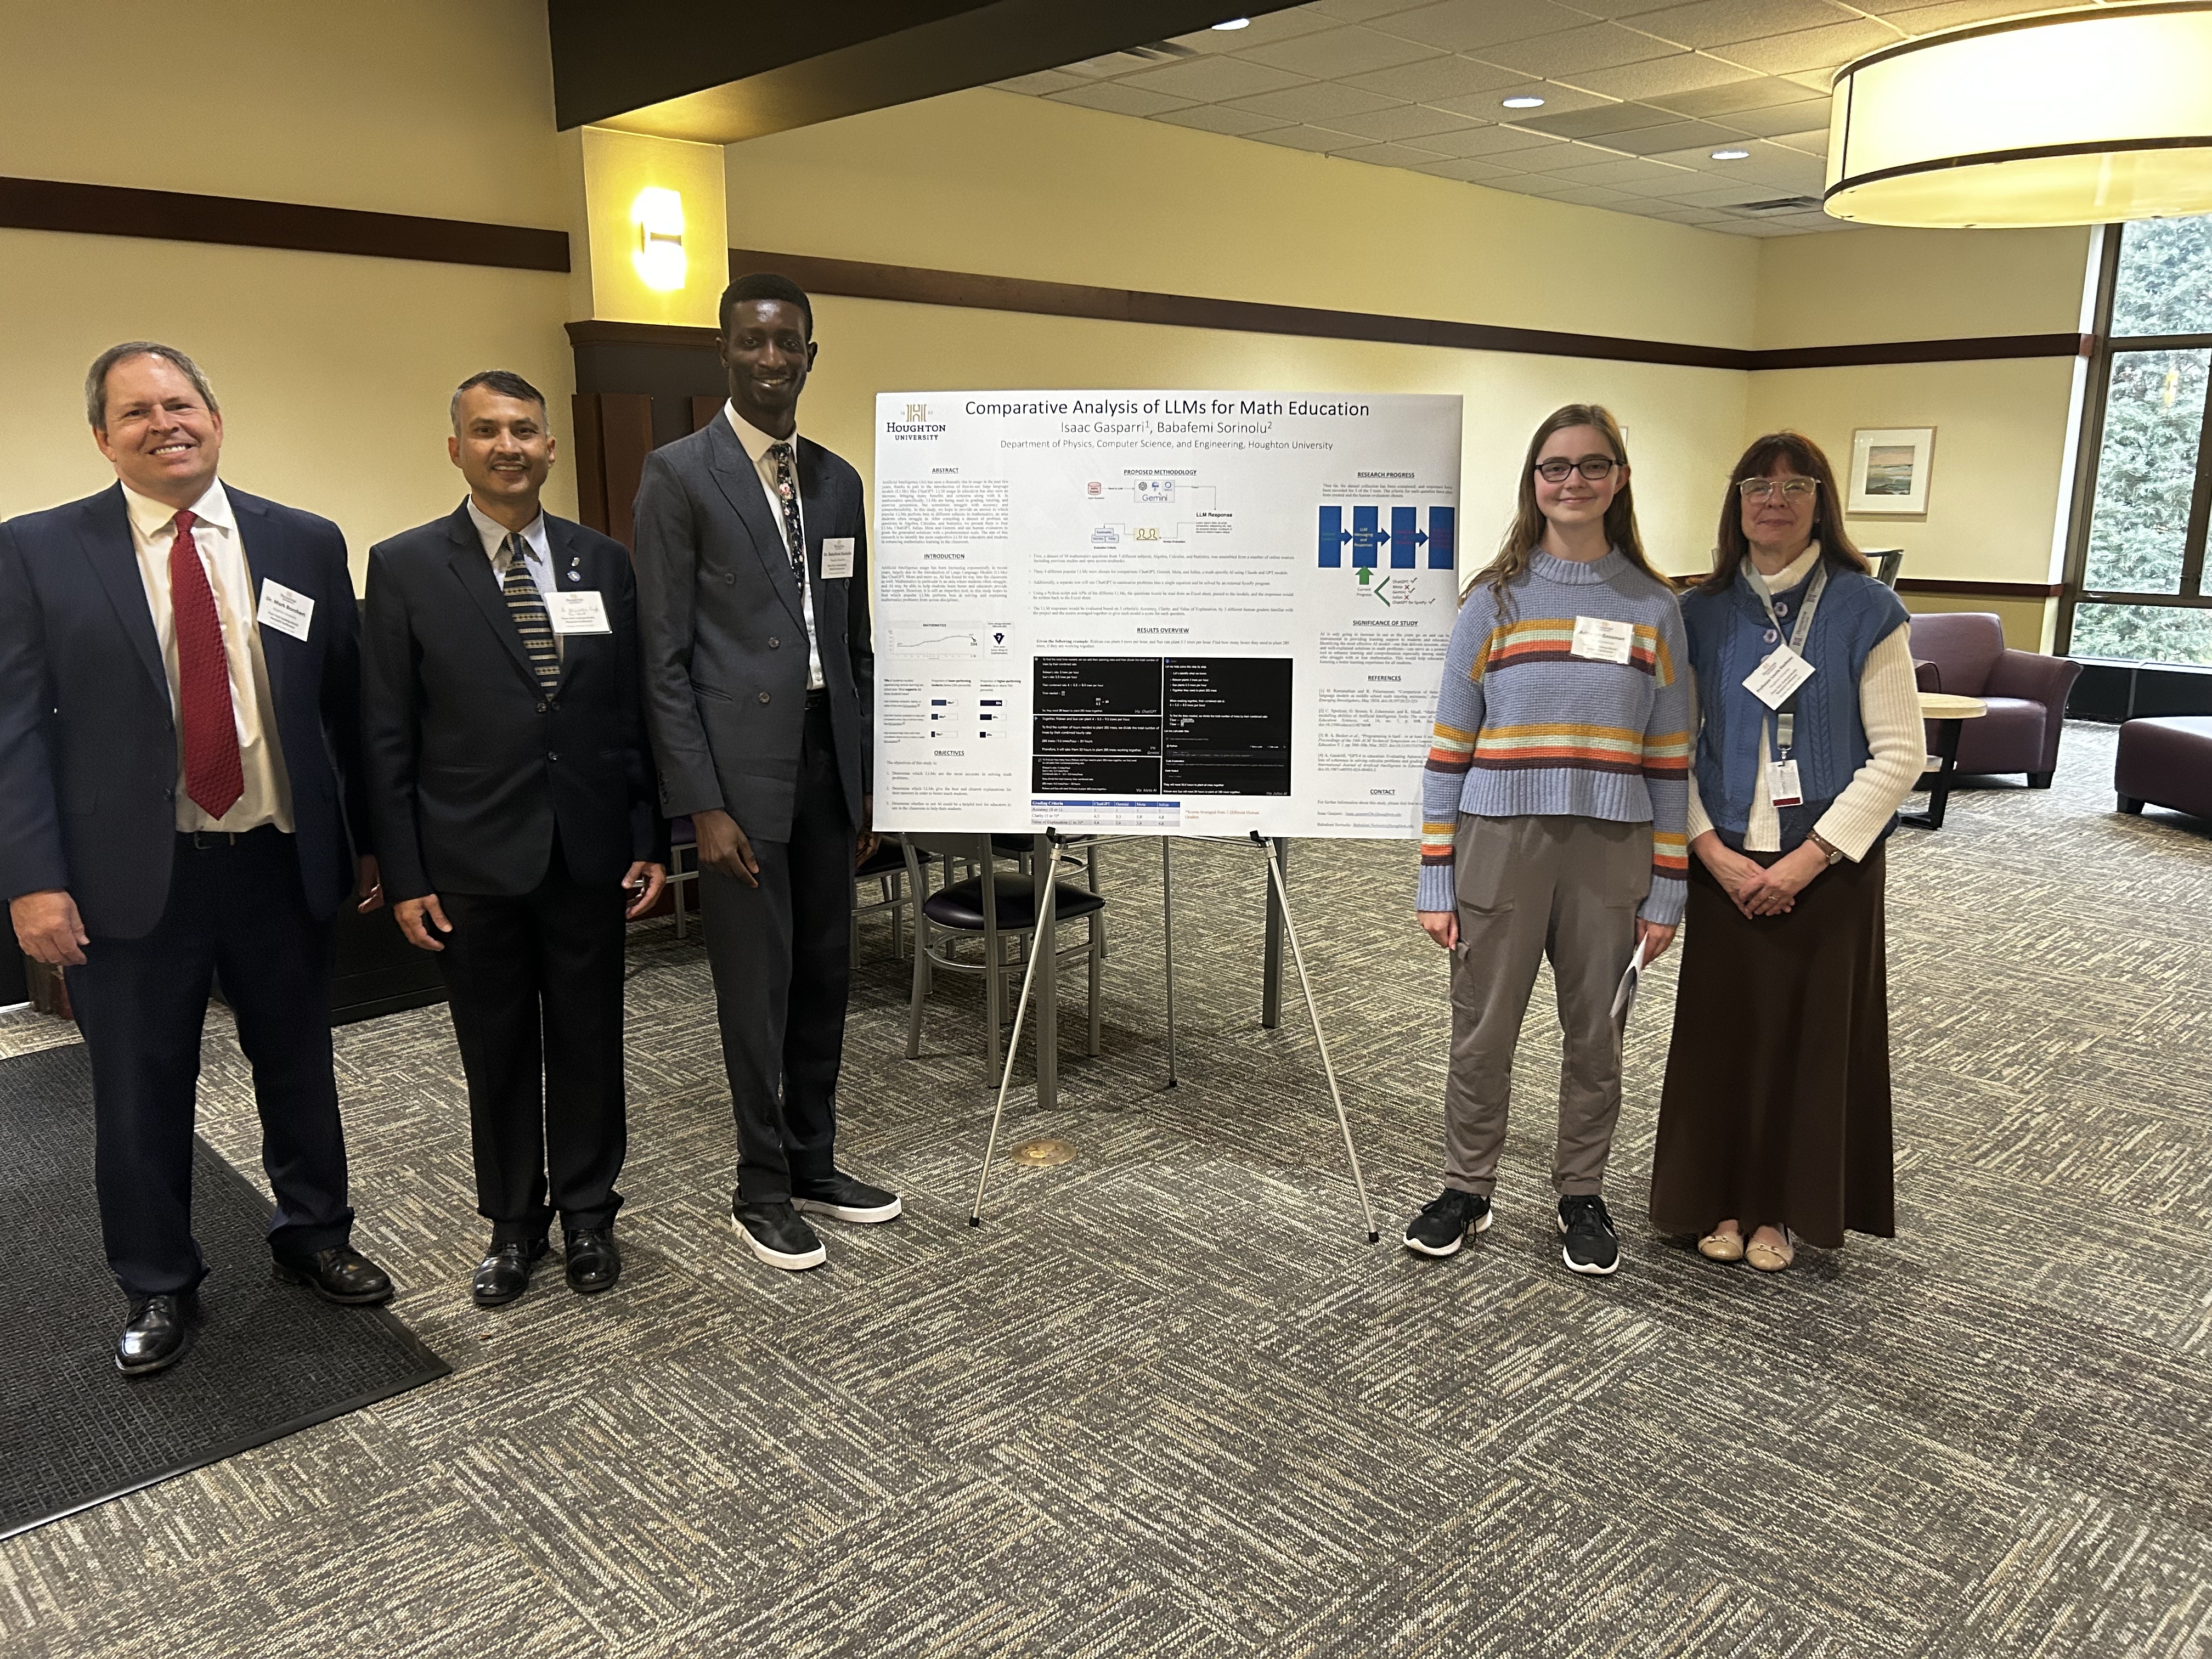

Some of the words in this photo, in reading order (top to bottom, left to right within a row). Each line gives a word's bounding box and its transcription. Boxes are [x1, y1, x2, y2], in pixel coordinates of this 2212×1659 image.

[966, 400, 1067, 417] Comparative
[1073, 399, 1137, 417] Analysis
[1143, 399, 1160, 414] of
[1165, 400, 1205, 414] LLMs
[1211, 399, 1234, 414] for
[1240, 400, 1282, 415] Math
[1289, 400, 1368, 416] Education
[887, 421, 946, 432] HOUGHTON
[1062, 422, 1090, 432] Isaac
[1158, 421, 1212, 432] Babafemi
[1001, 440, 1049, 449] Department
[1052, 439, 1060, 447] of
[1063, 439, 1094, 449] Physics,
[1097, 440, 1138, 449] Computer
[1141, 439, 1173, 449] Science,
[1176, 439, 1191, 448] and
[1194, 440, 1245, 450] Engineering,
[1248, 440, 1289, 450] Houghton
[1292, 441, 1333, 451] University
